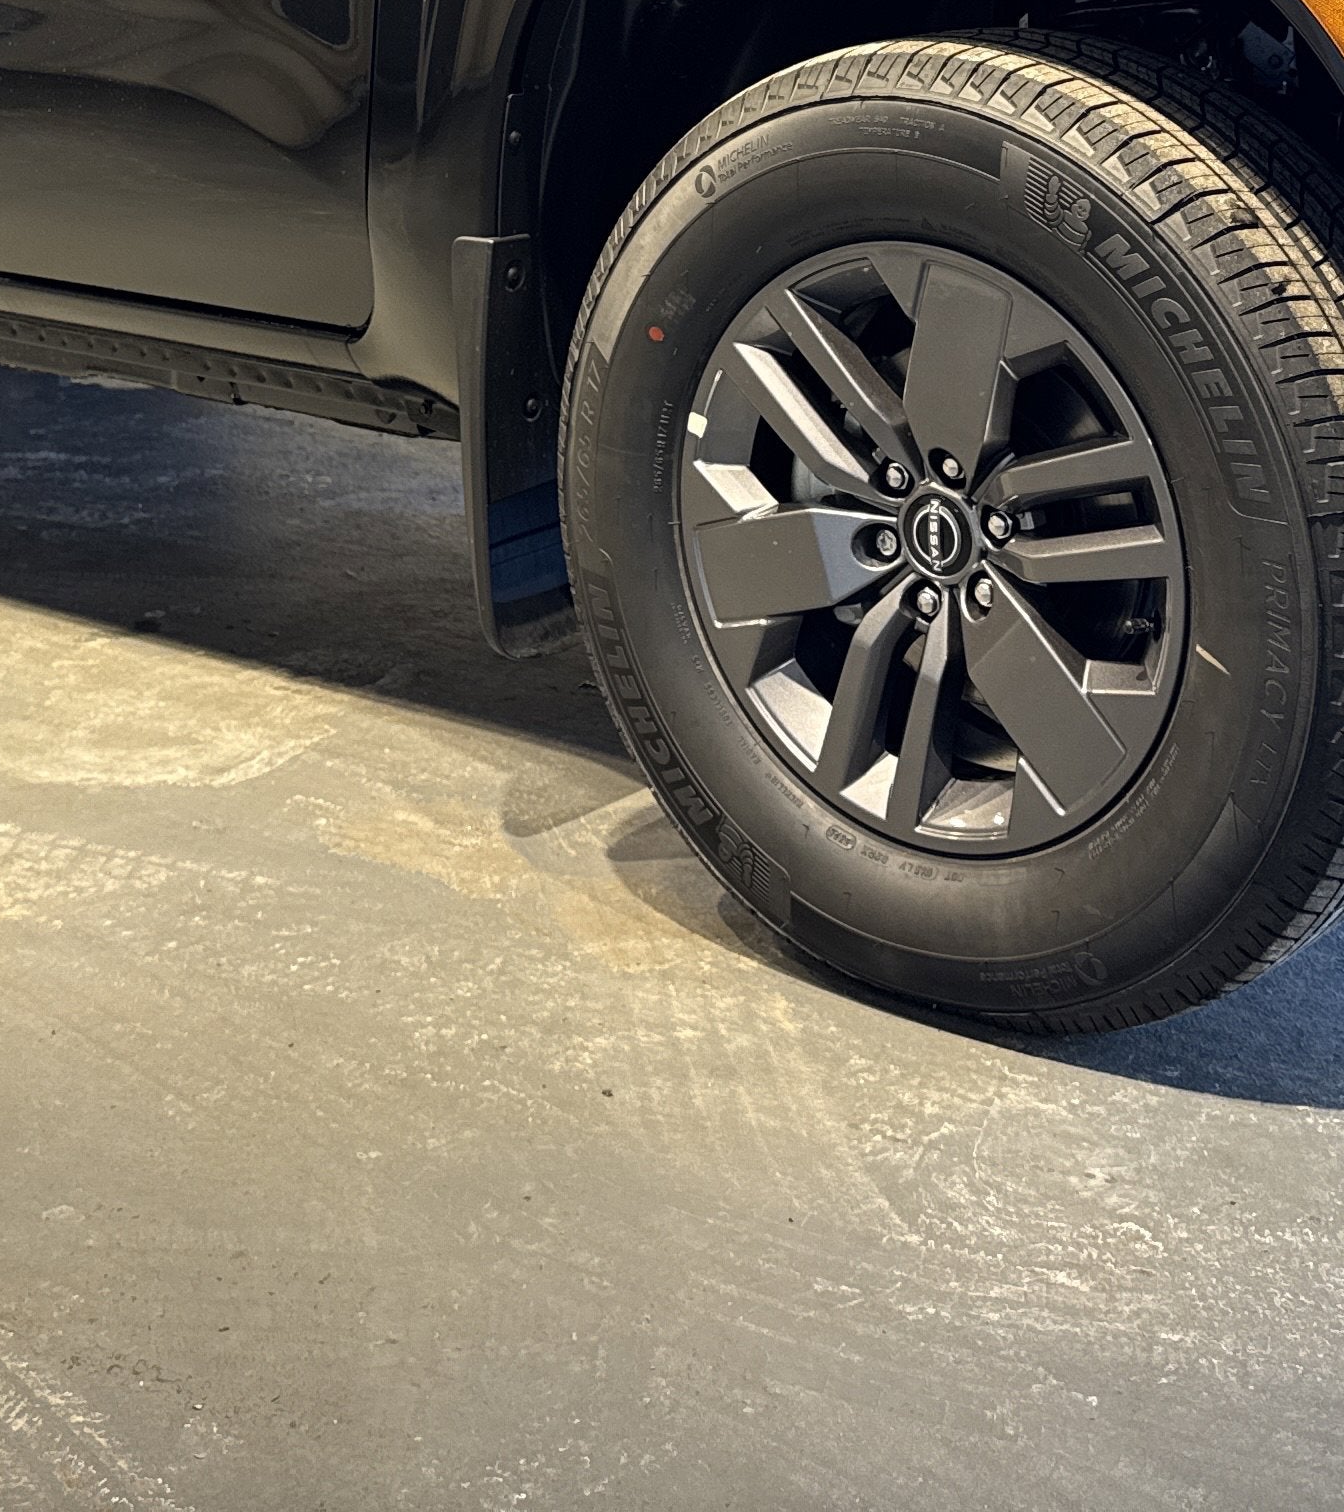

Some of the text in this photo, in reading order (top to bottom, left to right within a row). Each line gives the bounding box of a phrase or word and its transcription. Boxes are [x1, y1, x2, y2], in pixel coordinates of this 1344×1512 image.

[716, 133, 771, 172] MICHELIN
[1094, 233, 1272, 504] MICHELIN
[929, 498, 942, 572] NISSAN
[587, 582, 715, 827] MICHELIN
[1259, 560, 1292, 730] PRIMACY
